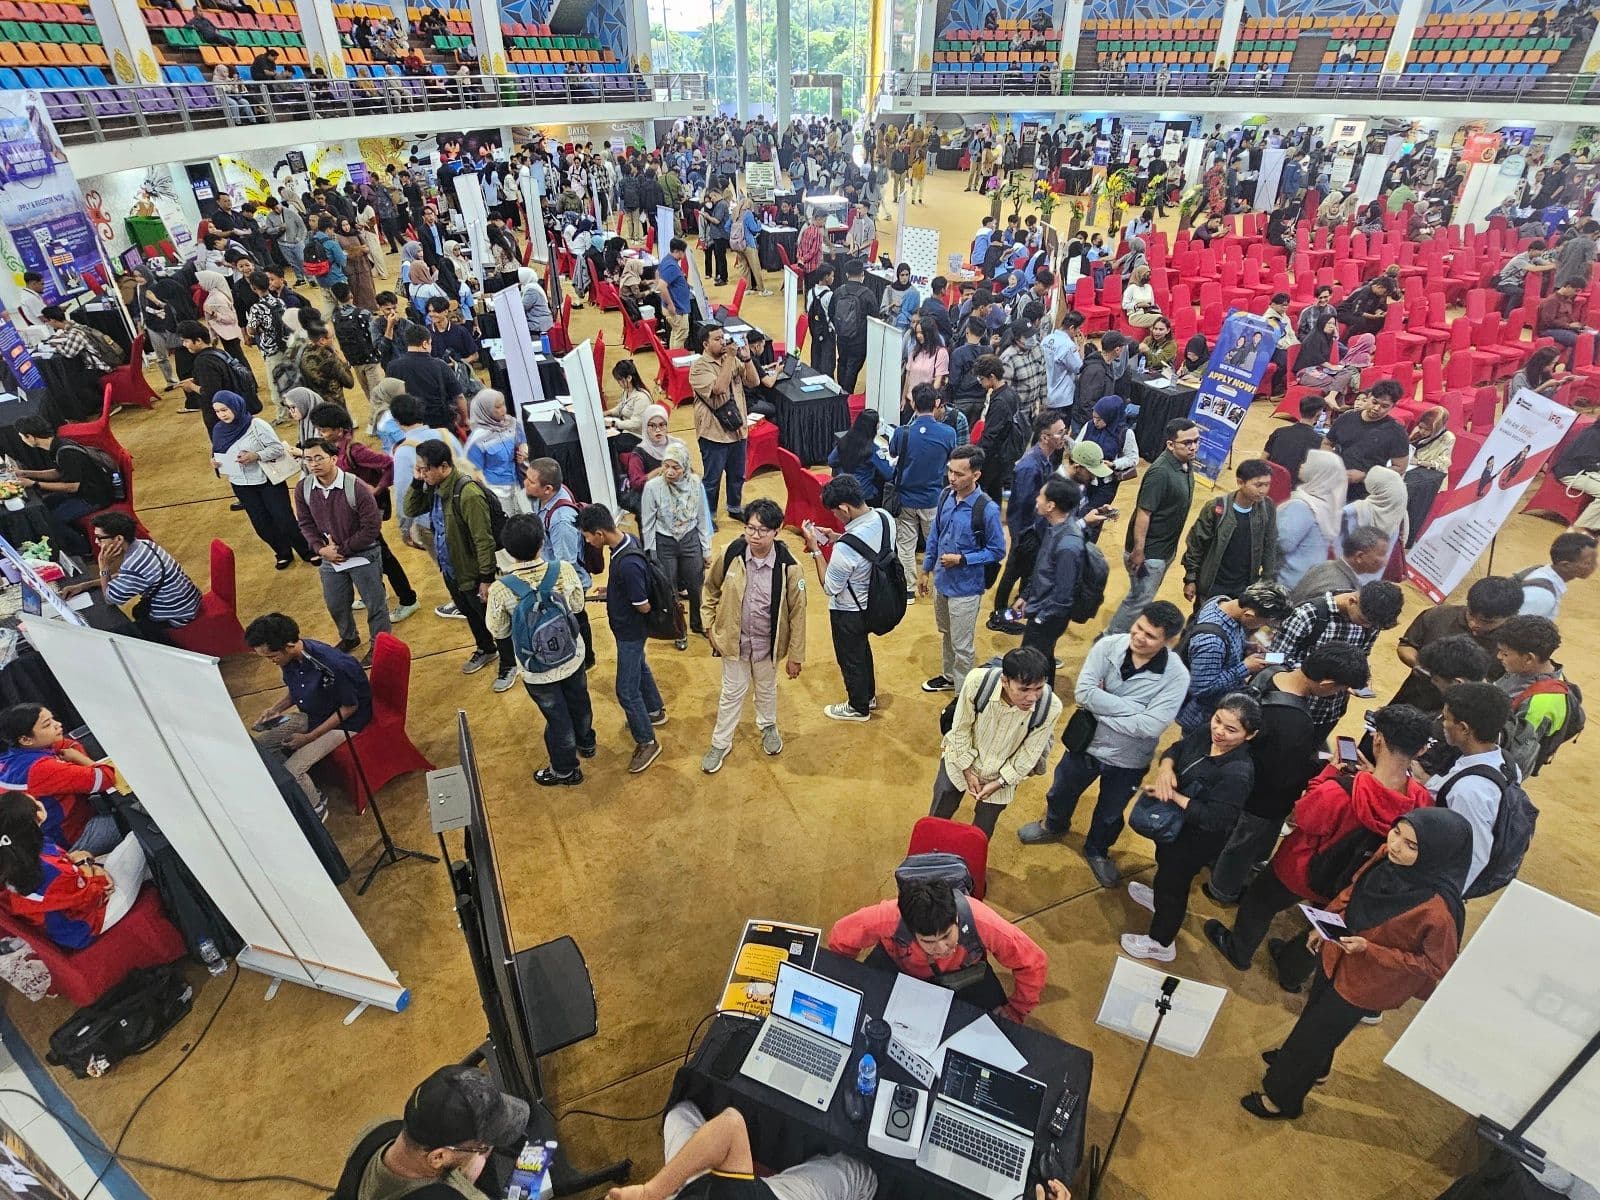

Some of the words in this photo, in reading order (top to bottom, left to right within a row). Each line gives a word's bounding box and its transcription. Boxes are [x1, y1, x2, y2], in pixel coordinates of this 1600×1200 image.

[1208, 371, 1234, 384] APPLY
[1231, 379, 1257, 395] NOW!
[1547, 412, 1562, 425] IFG
[891, 1042, 931, 1076] RAHAT
